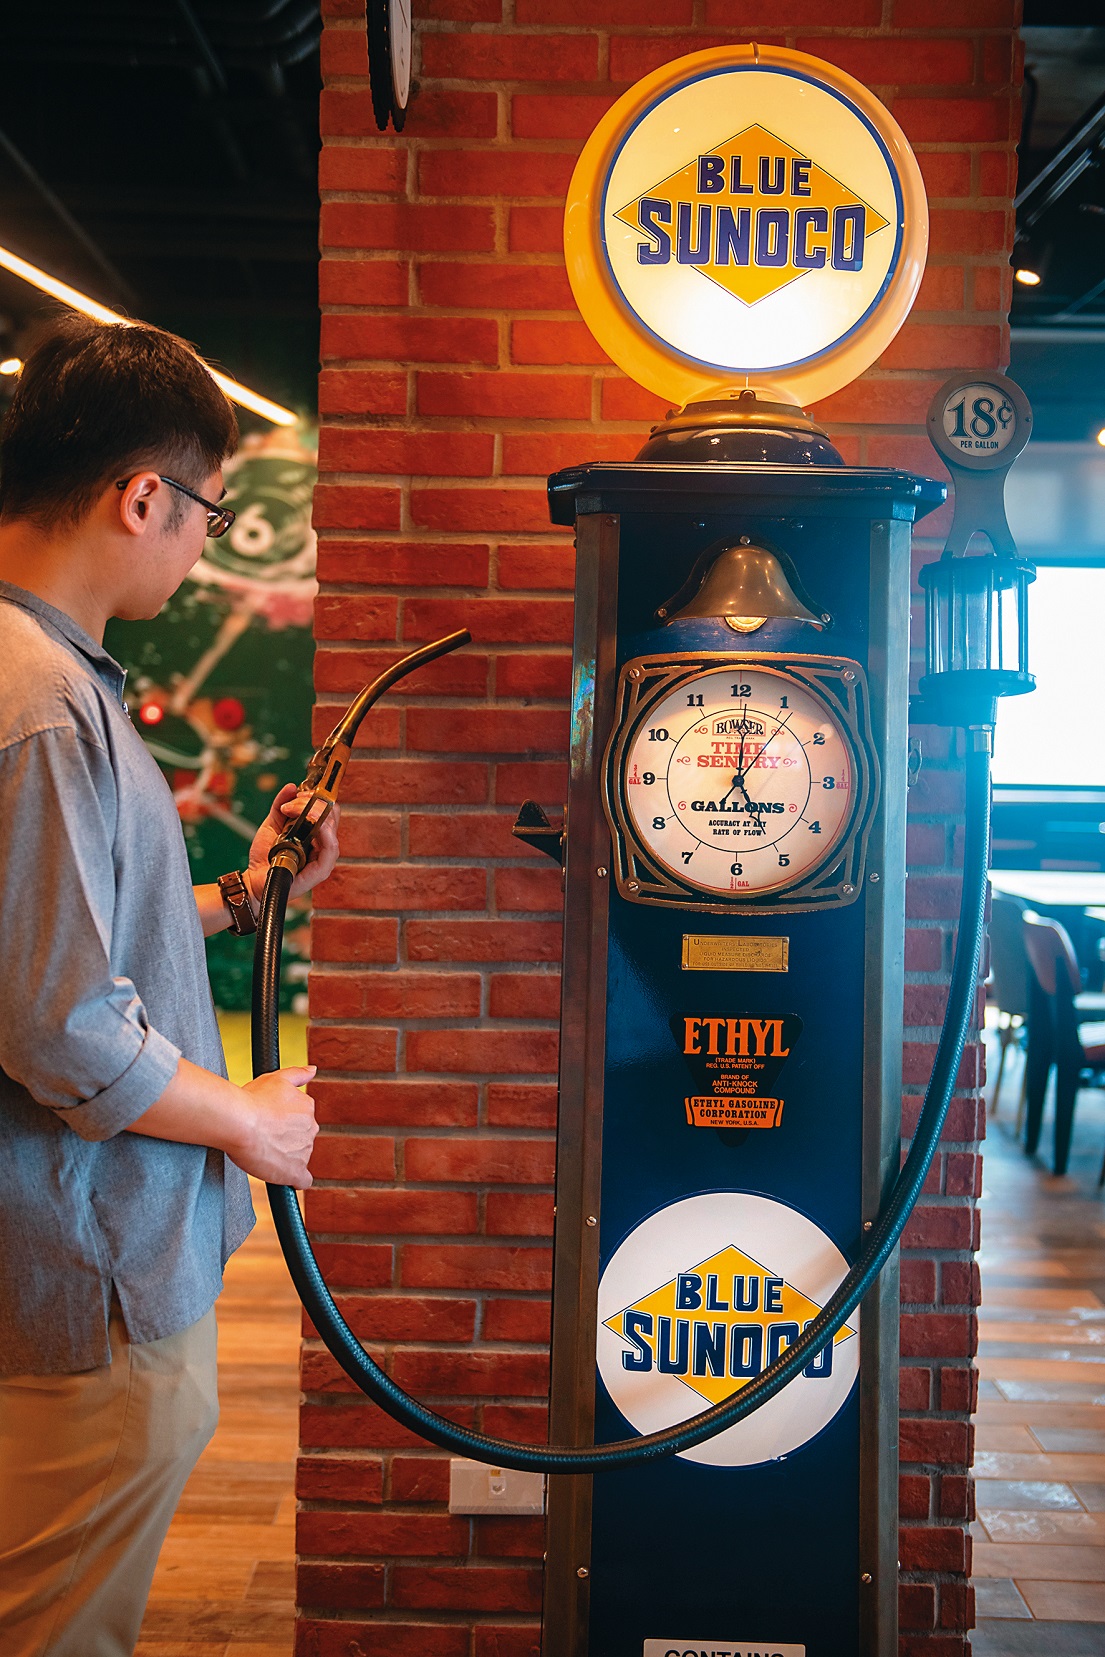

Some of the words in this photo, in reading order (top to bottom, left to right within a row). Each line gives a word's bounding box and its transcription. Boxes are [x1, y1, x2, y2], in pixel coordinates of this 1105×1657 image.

[697, 154, 812, 196] BLUE
[636, 196, 866, 272] SUNOCO
[947, 396, 1013, 439] 18¢
[960, 440, 972, 448] PER
[974, 440, 999, 449] GALLON
[730, 684, 752, 697] 12
[686, 694, 705, 707] 11
[779, 696, 789, 708] 1
[716, 718, 764, 735] BOWSER
[648, 728, 669, 741] 10
[813, 732, 825, 745] 2
[711, 742, 767, 755] TIME
[697, 755, 781, 769] SENTRY
[642, 771, 656, 785] 9
[822, 776, 835, 789] 3
[691, 801, 785, 813] GALLONS
[652, 817, 666, 830] 8
[808, 821, 821, 834] 4
[681, 852, 694, 865] 7
[778, 854, 790, 867] 5
[731, 863, 743, 876] 6
[683, 1017, 790, 1057] ETHYL
[711, 1080, 758, 1088] ANTI-KNOCK
[713, 1086, 756, 1094] COMPOUND
[693, 1099, 725, 1107] ETHYL
[728, 1100, 776, 1109] GASOLINE
[700, 1109, 767, 1118] CORPORATION
[675, 1273, 784, 1313] BLUE
